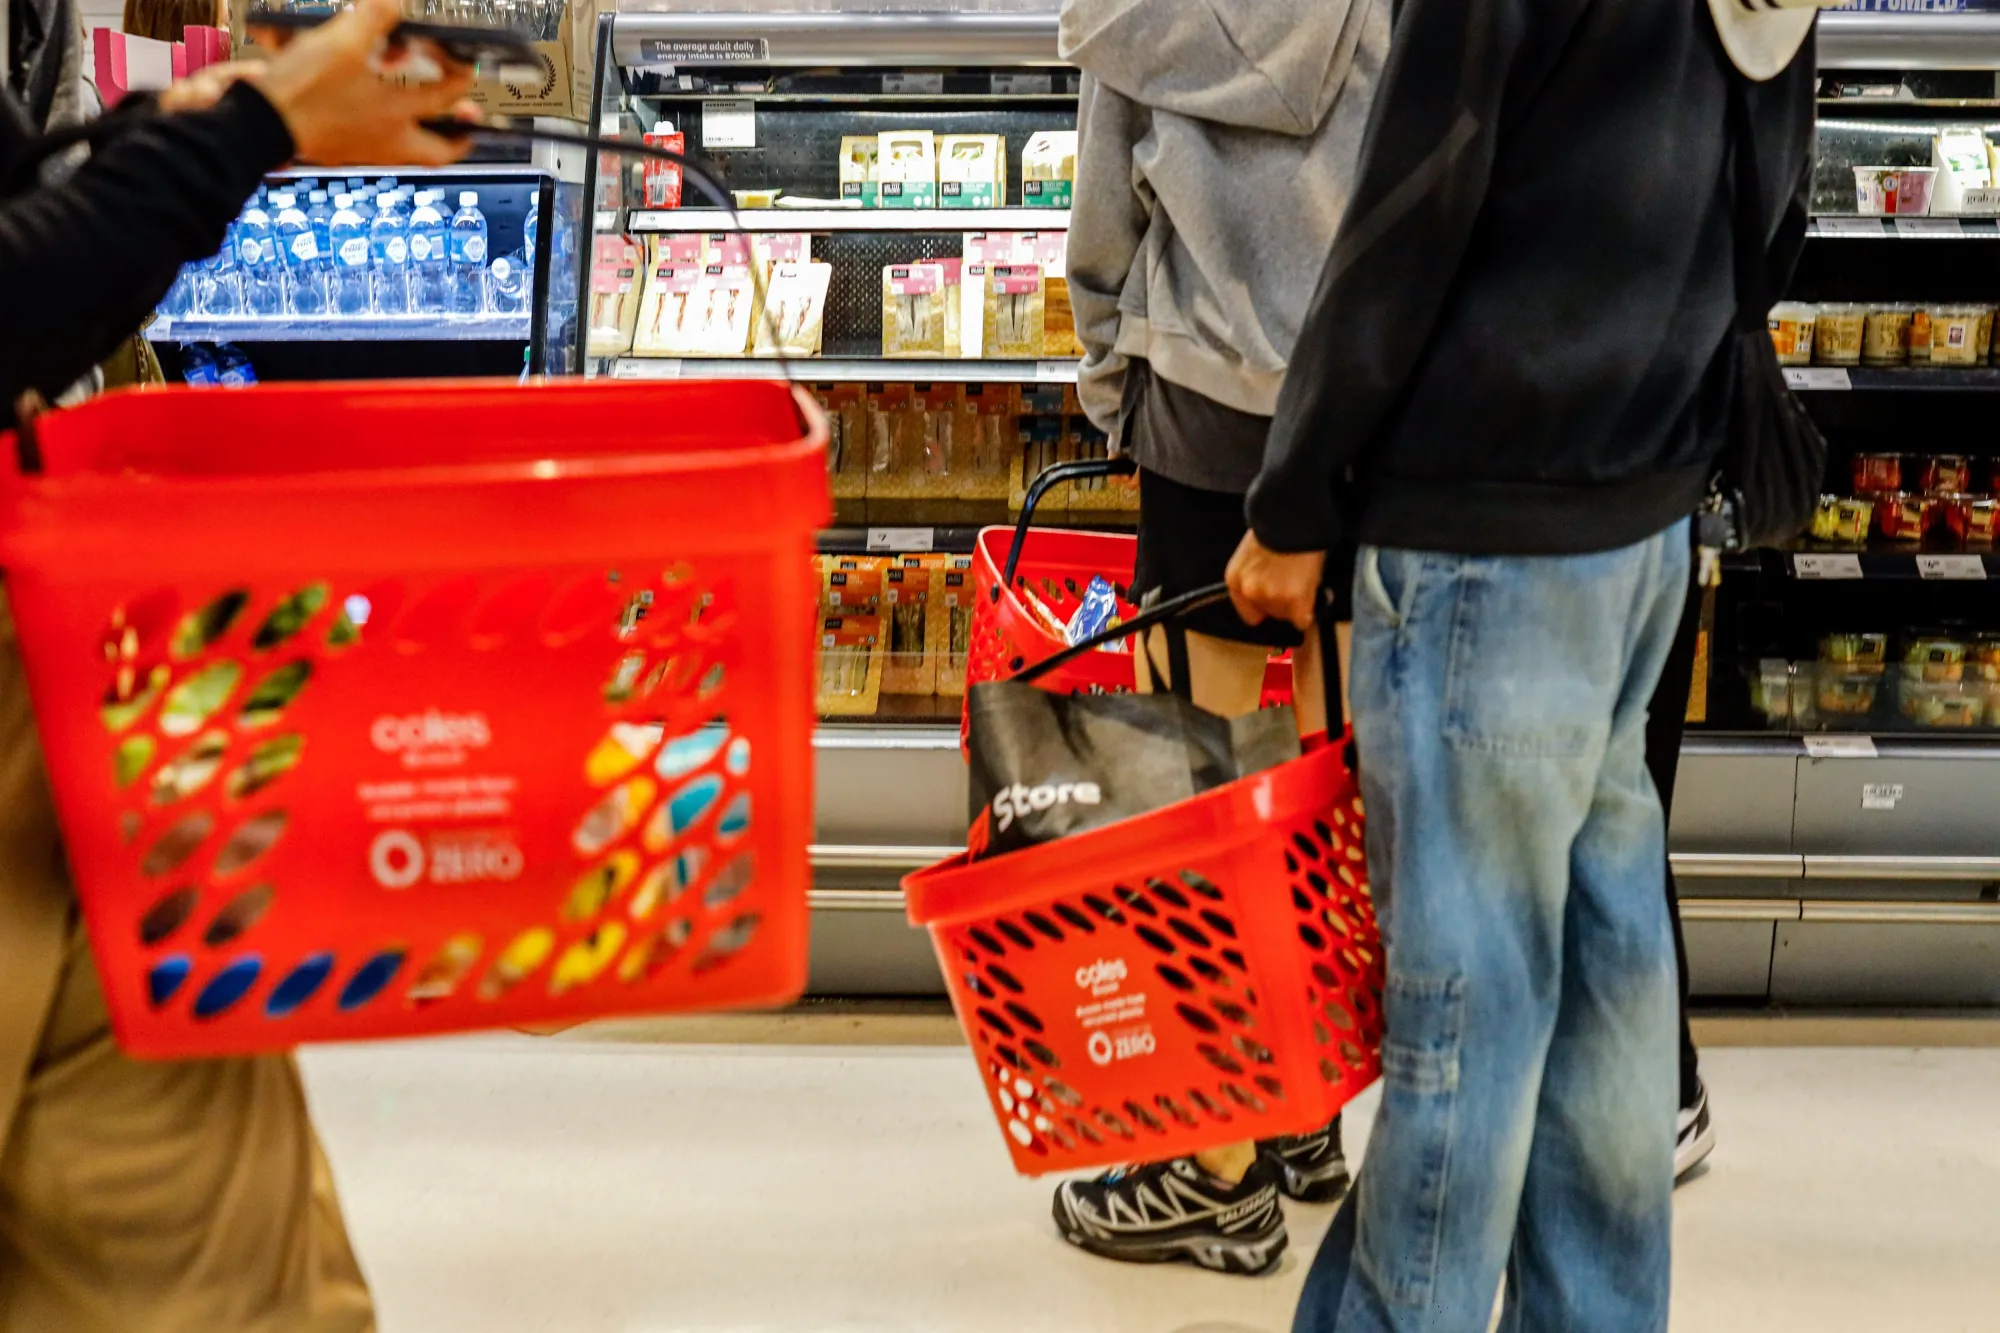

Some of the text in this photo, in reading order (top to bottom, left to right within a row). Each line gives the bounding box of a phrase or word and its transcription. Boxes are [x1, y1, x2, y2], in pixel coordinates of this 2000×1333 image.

[655, 41, 754, 53] The average adult daily
[657, 52, 686, 61] energy
[688, 52, 715, 60] intake
[716, 52, 723, 60] is
